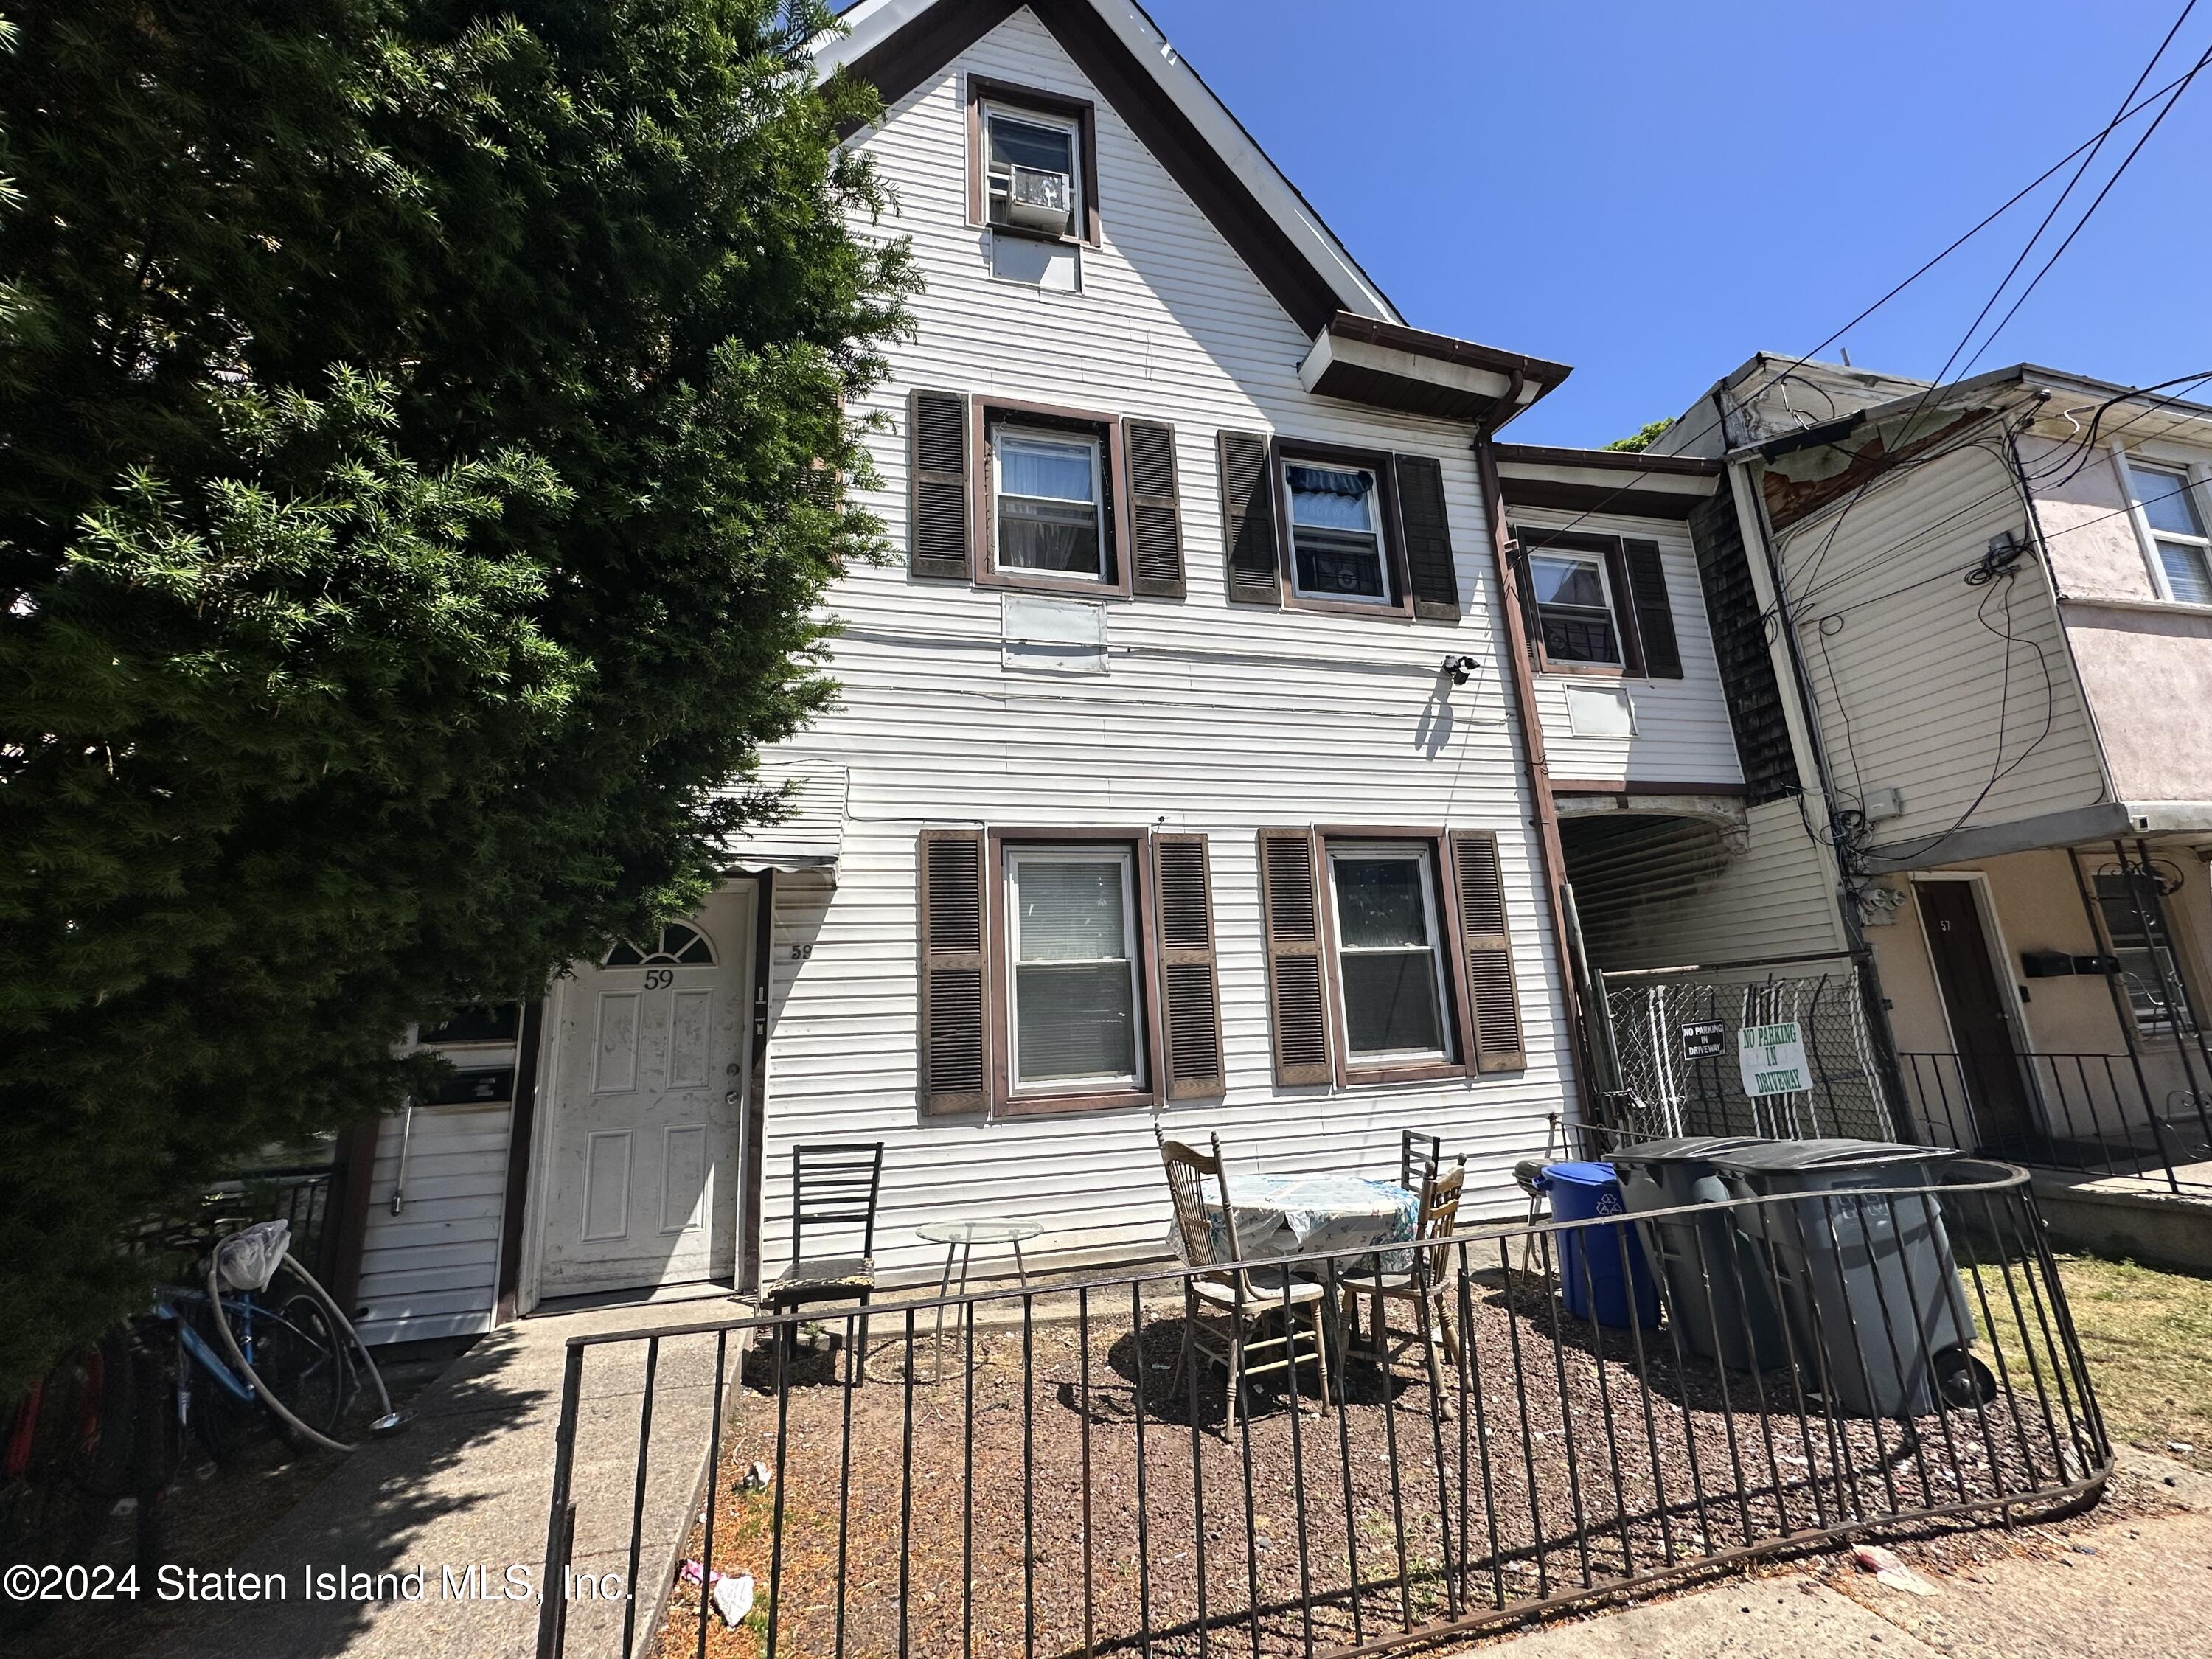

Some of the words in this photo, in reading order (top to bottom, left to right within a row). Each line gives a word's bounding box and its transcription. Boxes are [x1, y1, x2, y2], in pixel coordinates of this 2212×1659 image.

[1940, 920, 1950, 931] 57
[791, 945, 812, 959] 59
[644, 970, 674, 990] 59
[1683, 1027, 1694, 1037] NO
[1695, 1024, 1722, 1036] PARKING
[1743, 1029, 1754, 1048] NO
[1758, 1023, 1796, 1046] PARKING
[1700, 1035, 1708, 1044] IN
[1688, 1043, 1720, 1055] DRIVEWAY
[1765, 1046, 1778, 1066] IN
[1755, 1068, 1801, 1093] DRIVEWAY
